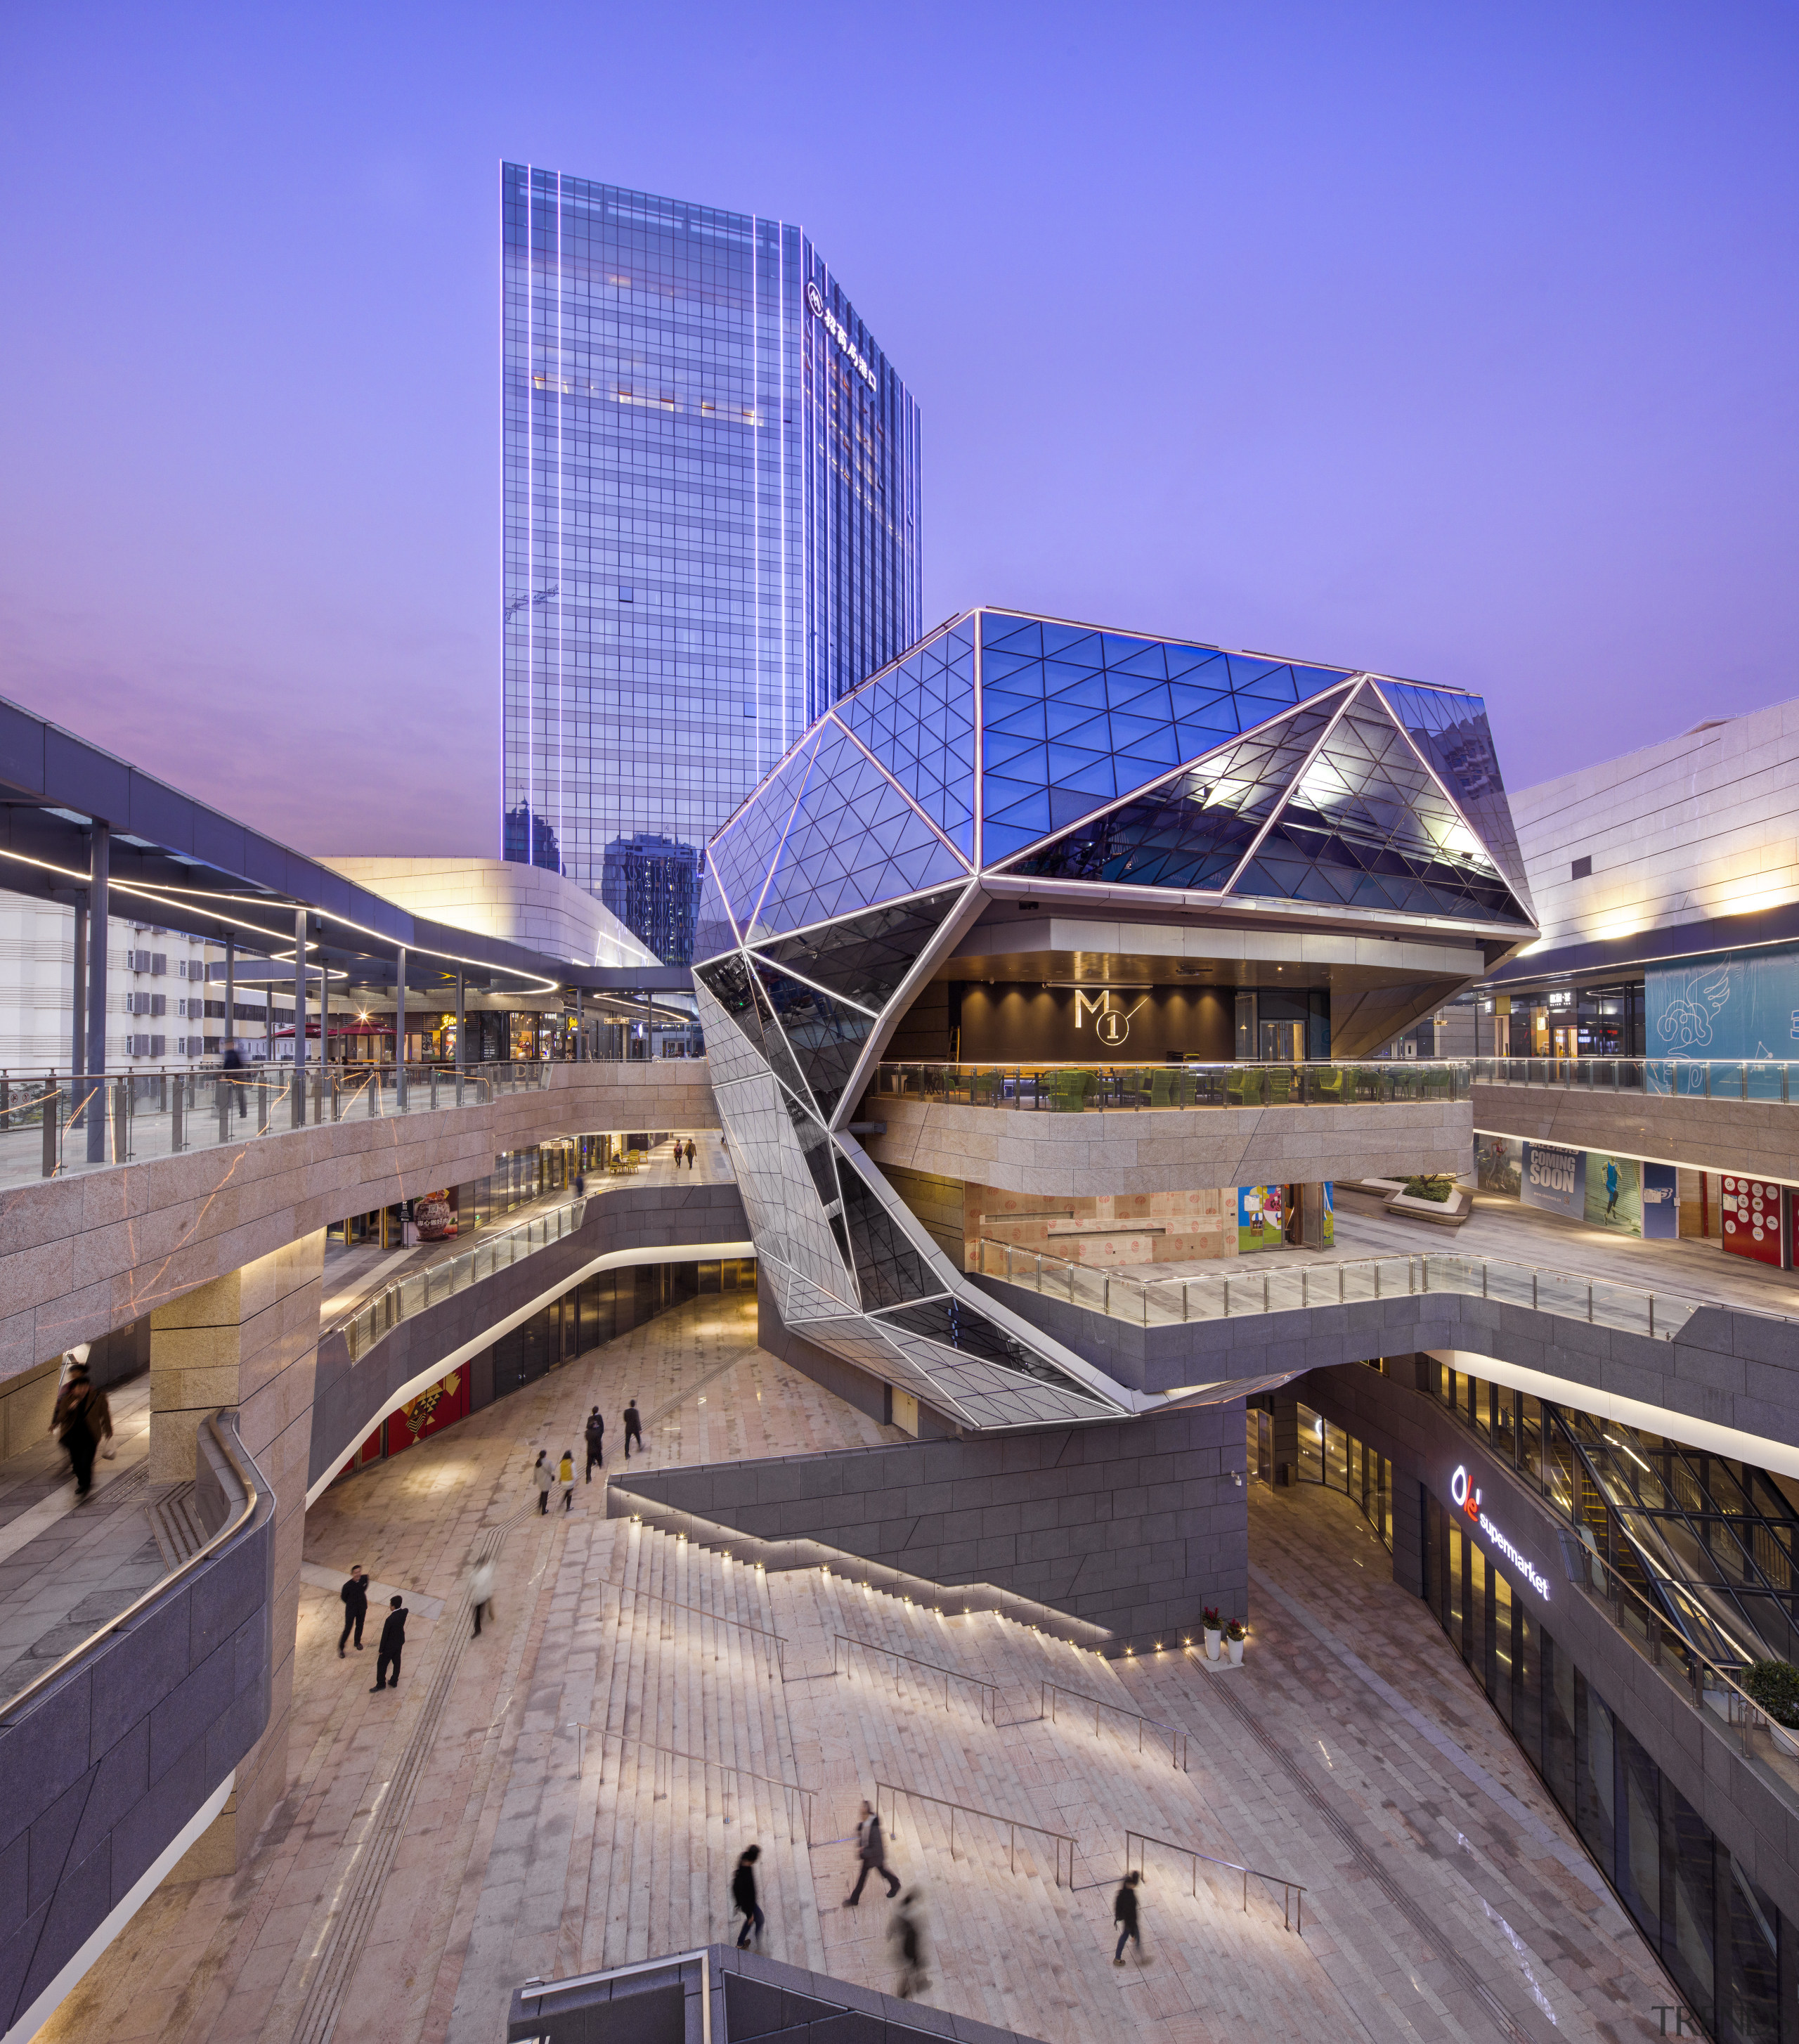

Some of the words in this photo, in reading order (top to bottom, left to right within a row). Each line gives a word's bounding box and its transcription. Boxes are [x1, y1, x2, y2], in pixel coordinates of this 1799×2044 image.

[824, 307, 877, 392] 招商局港口
[1530, 1164, 1575, 1194] SOON
[1531, 1150, 1576, 1172] COMING
[1479, 1513, 1551, 1601] supermarket
